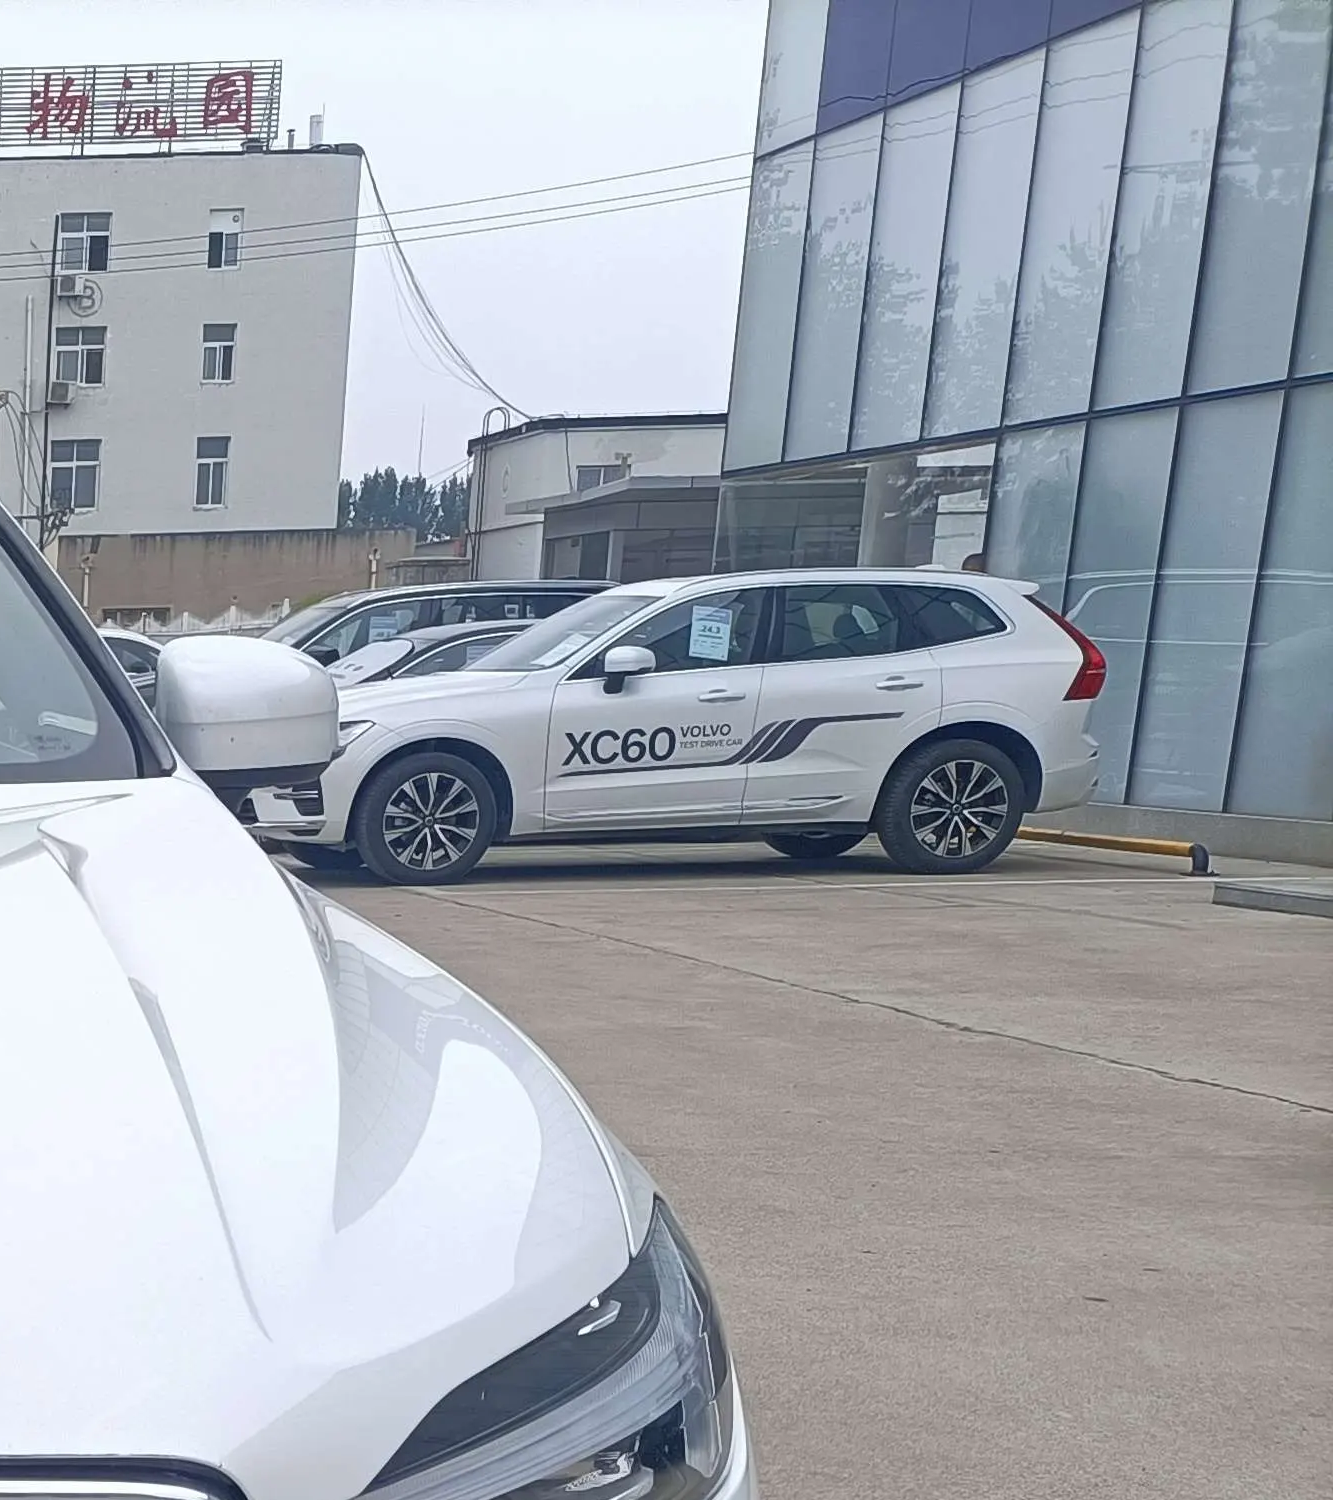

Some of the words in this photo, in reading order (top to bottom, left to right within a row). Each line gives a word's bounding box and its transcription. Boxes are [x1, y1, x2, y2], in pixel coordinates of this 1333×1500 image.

[679, 724, 732, 738] VOLVO
[562, 727, 676, 766] XC60
[679, 740, 699, 749] TEST
[700, 739, 726, 748] DRIVE
[726, 738, 743, 747] CAR
